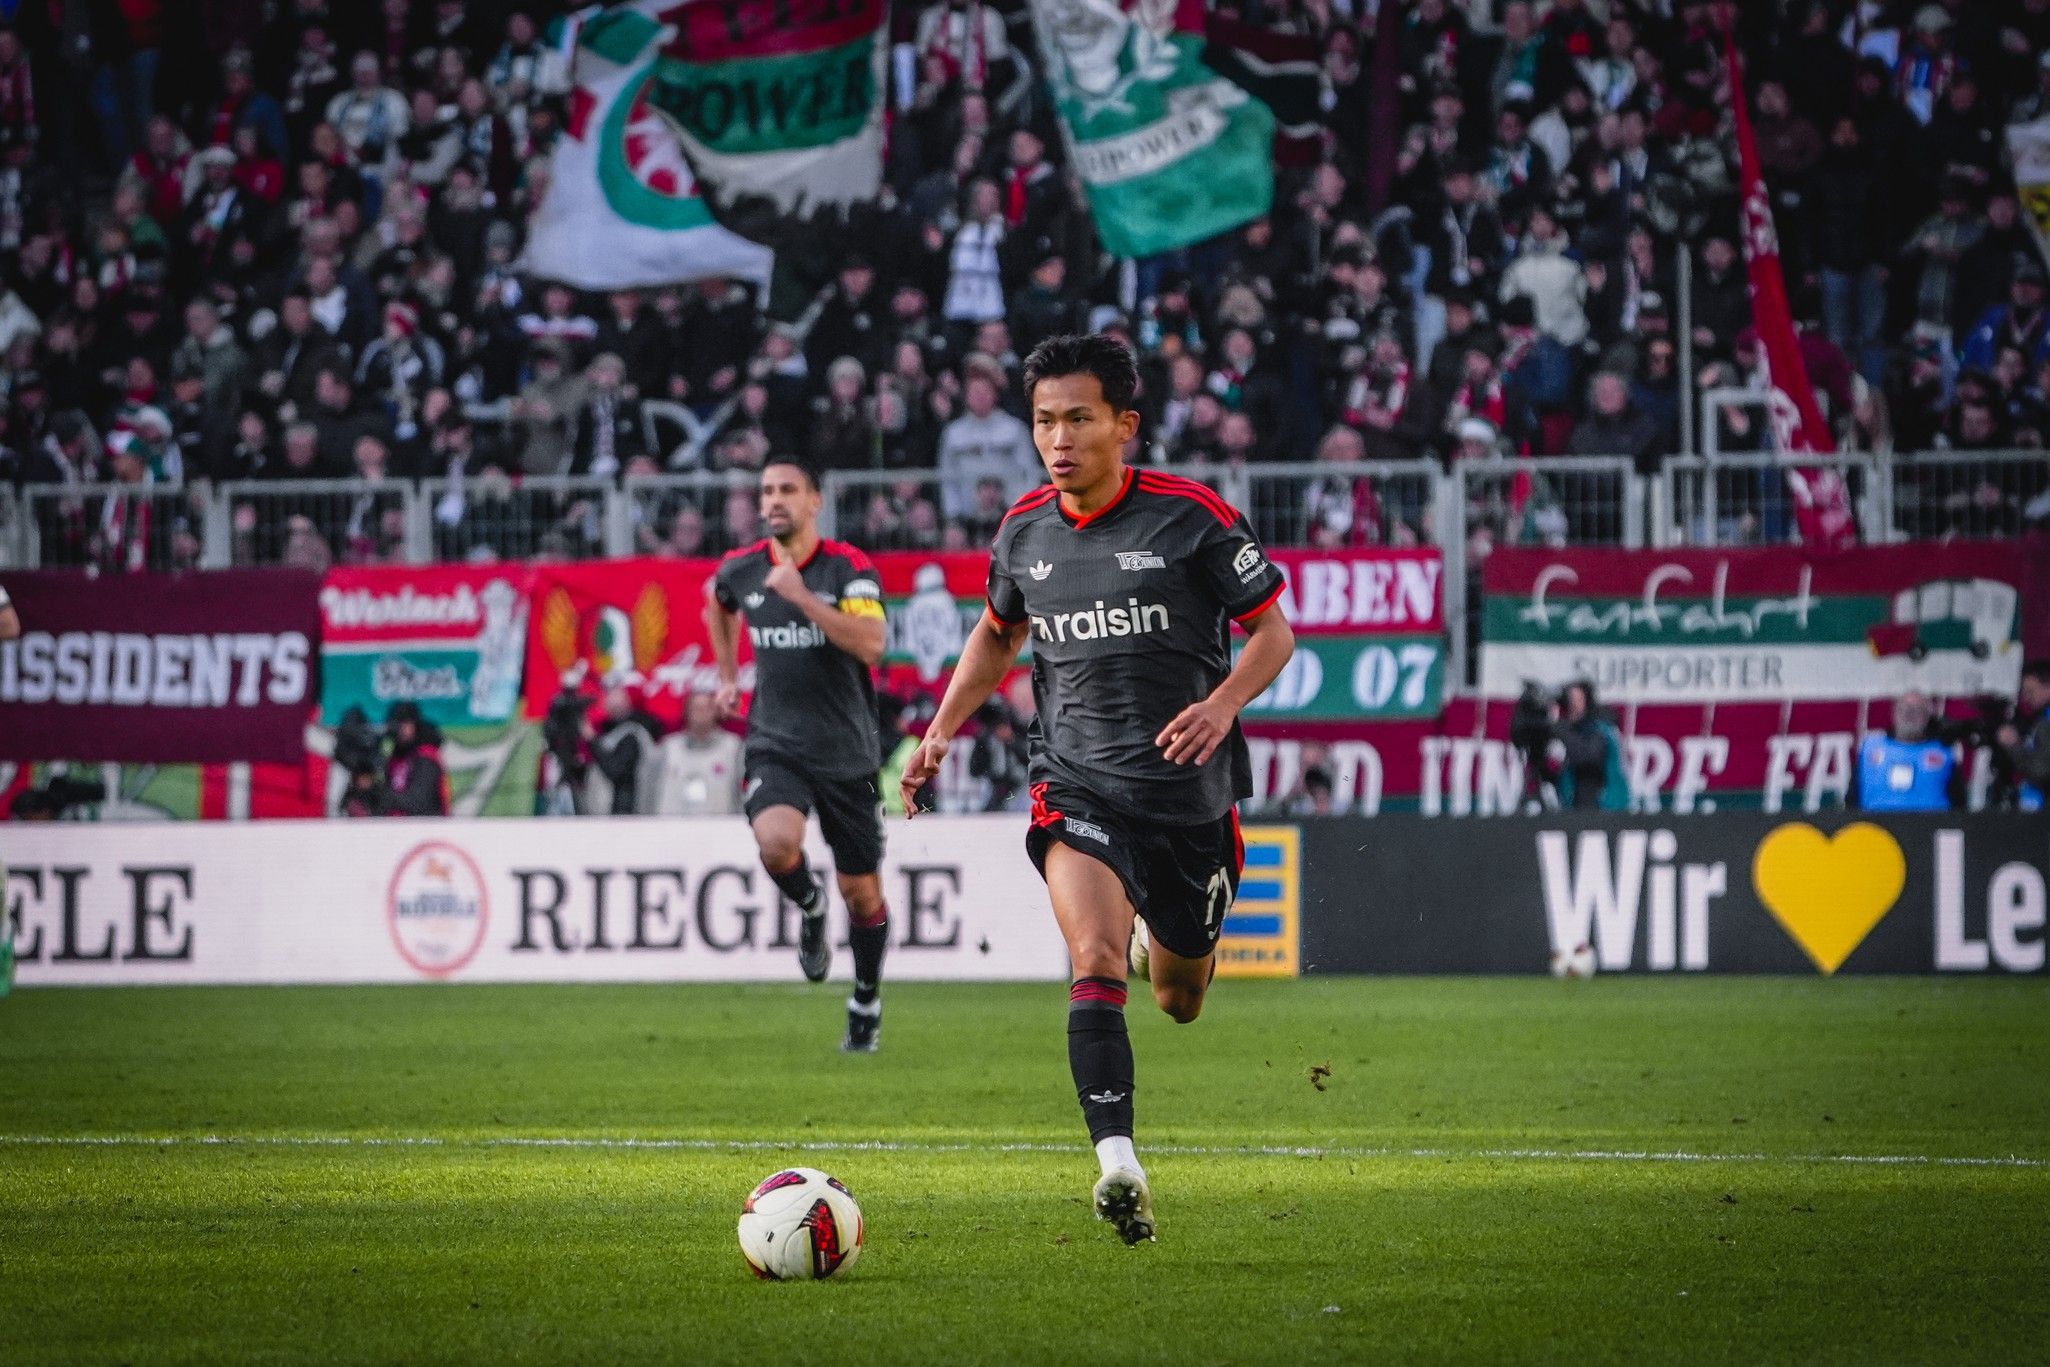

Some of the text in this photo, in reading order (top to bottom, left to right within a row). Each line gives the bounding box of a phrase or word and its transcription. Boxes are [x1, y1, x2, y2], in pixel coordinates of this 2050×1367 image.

[760, 620, 827, 649] raisi
[1053, 597, 1170, 642] raisin
[1352, 642, 1438, 710] 07
[1572, 654, 1784, 691] SUPPORTER
[509, 865, 962, 954] RIEGE
[1536, 827, 2048, 973] Wir Le
